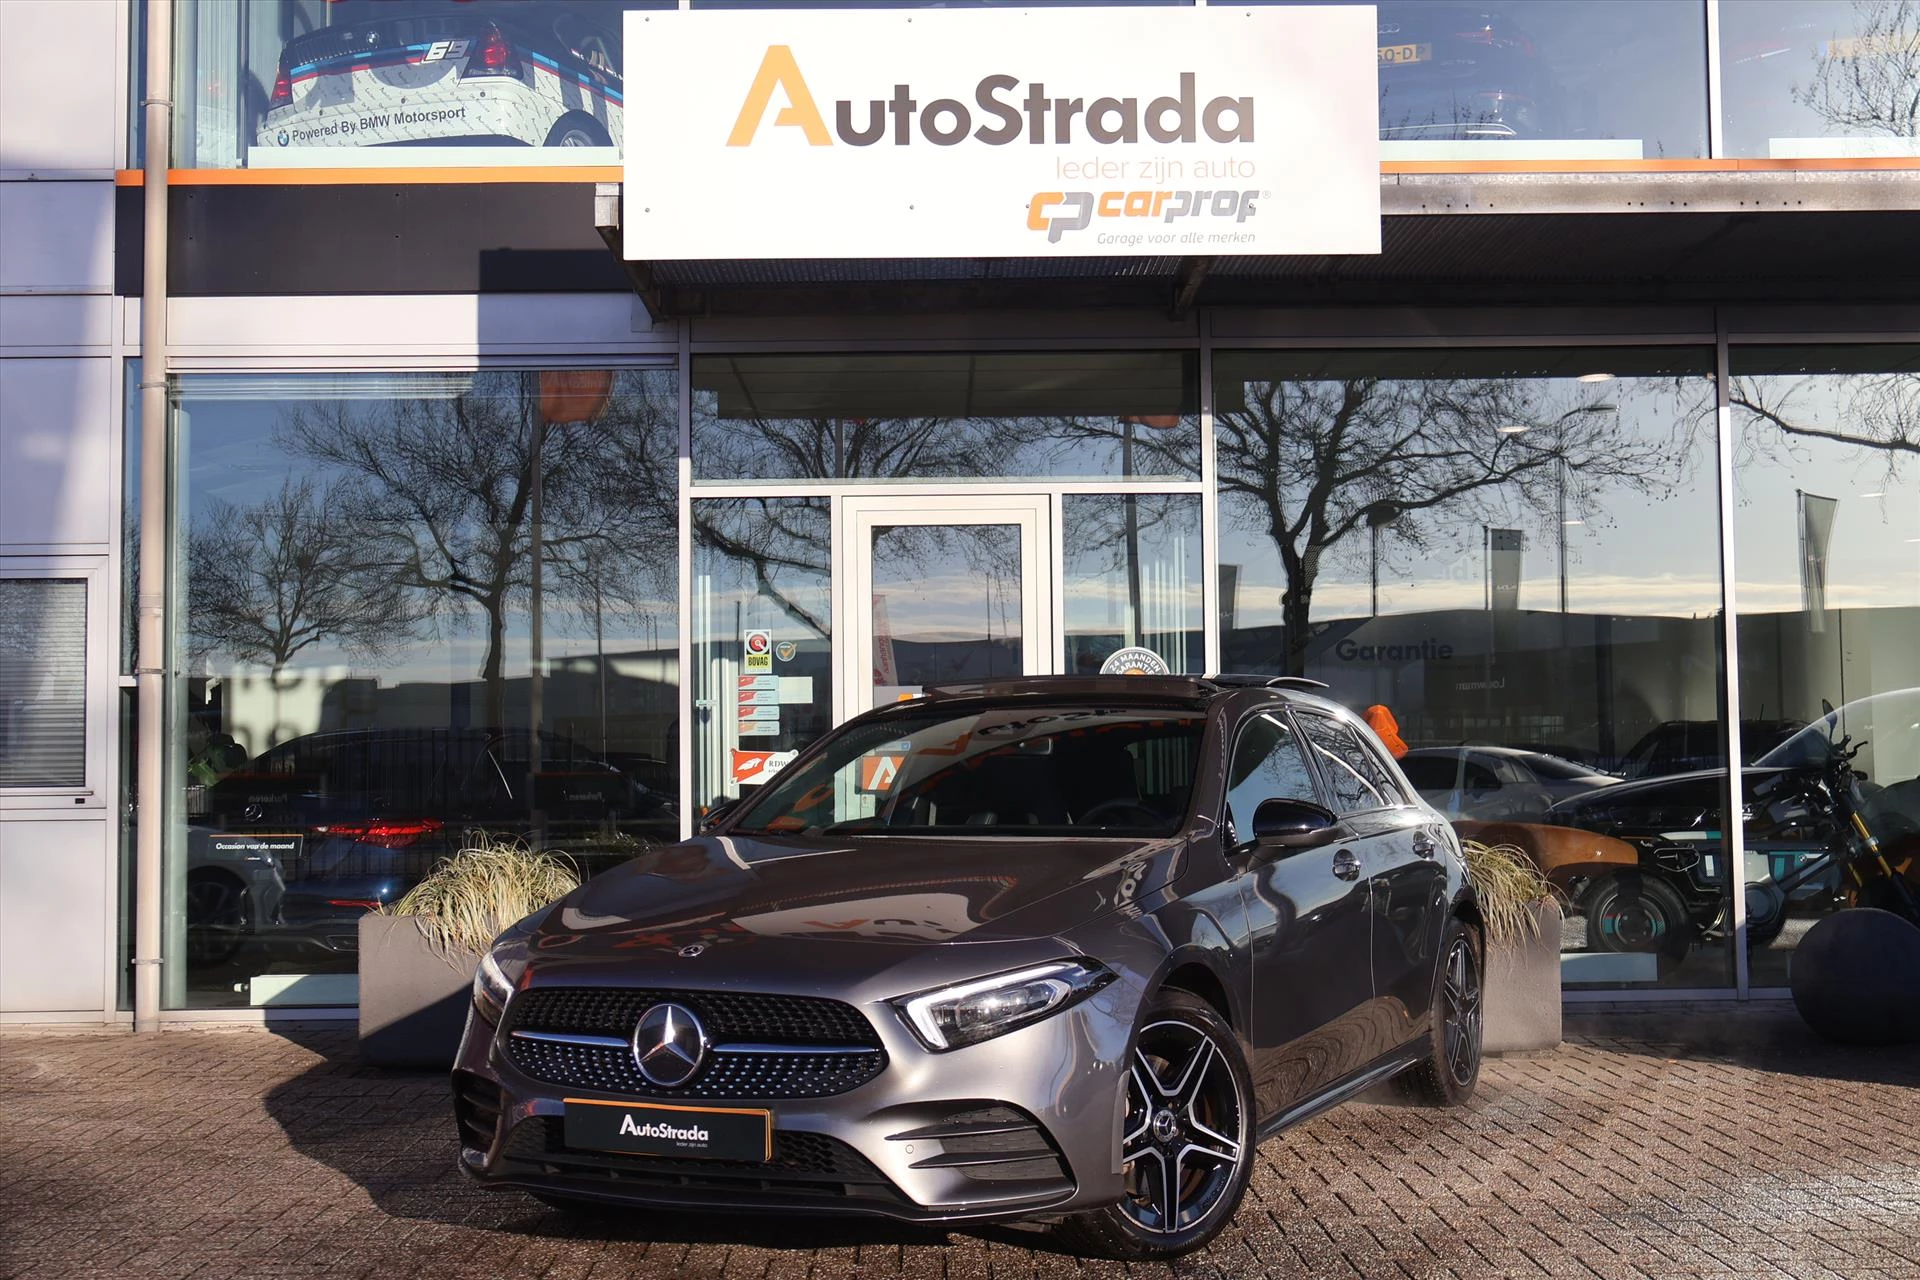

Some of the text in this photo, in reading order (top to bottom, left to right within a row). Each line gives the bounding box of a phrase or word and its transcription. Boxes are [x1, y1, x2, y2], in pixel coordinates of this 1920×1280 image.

[424, 40, 470, 62] 69
[726, 45, 1254, 147] AutoStrada
[292, 107, 466, 141] Powered By BMW Motorsport
[1056, 156, 1256, 184] Ieder zijn auto
[1097, 231, 1256, 247] Garage voor alle merken
[1335, 637, 1454, 662] Garantie
[747, 656, 769, 667] BOVAG
[1109, 653, 1162, 672] 24 MAANDEN
[215, 842, 246, 850] Occasion
[260, 842, 269, 850] de
[270, 842, 295, 850] maand
[619, 1114, 708, 1141] AutoStrada
